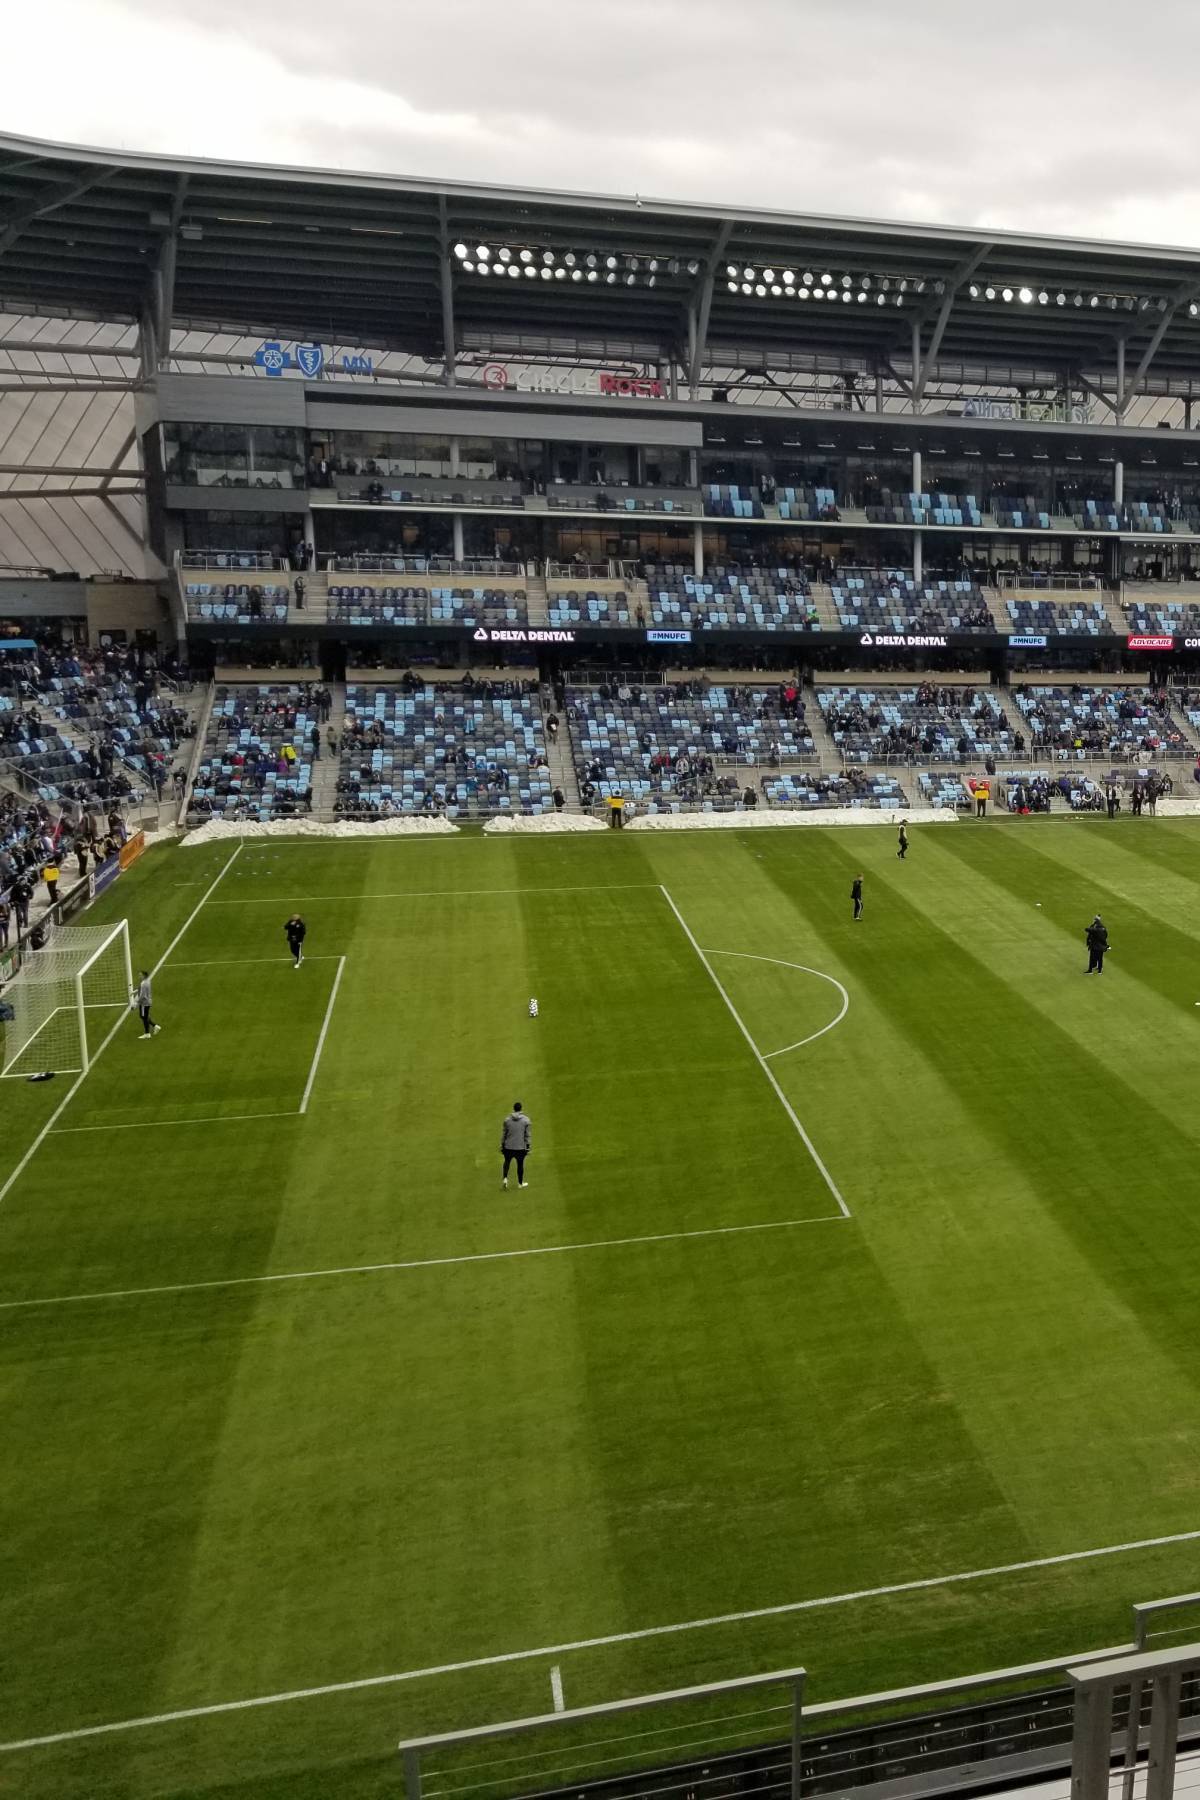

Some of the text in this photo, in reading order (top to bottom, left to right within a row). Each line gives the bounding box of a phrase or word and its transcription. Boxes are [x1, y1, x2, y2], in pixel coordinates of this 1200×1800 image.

[343, 355, 374, 375] MN
[491, 631, 574, 641] DELTA DENTAL
[876, 636, 946, 646] DELTA DENTAL
